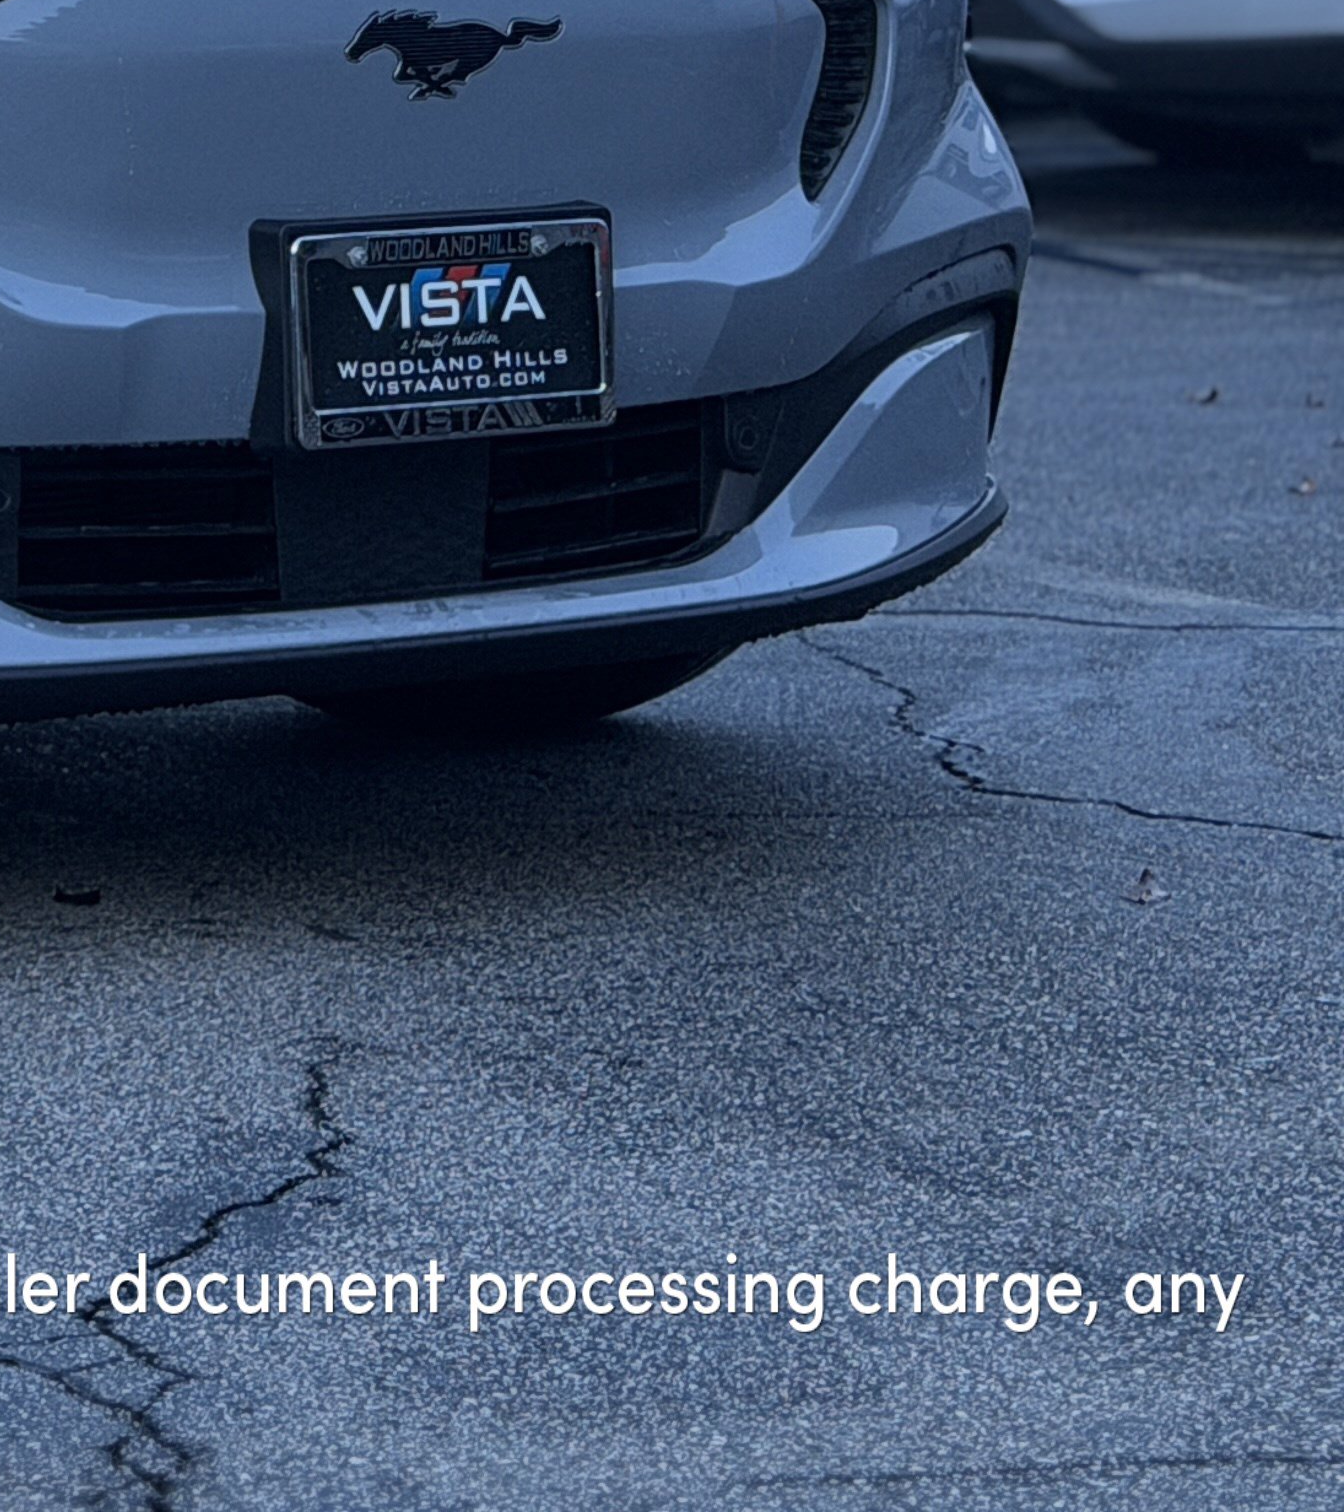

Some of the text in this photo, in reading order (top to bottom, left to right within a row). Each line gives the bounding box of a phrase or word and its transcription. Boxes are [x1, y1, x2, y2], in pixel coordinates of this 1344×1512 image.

[368, 231, 530, 263] WOODLAND HILLS
[352, 276, 546, 331] VISTA
[383, 402, 509, 439] VISTA
